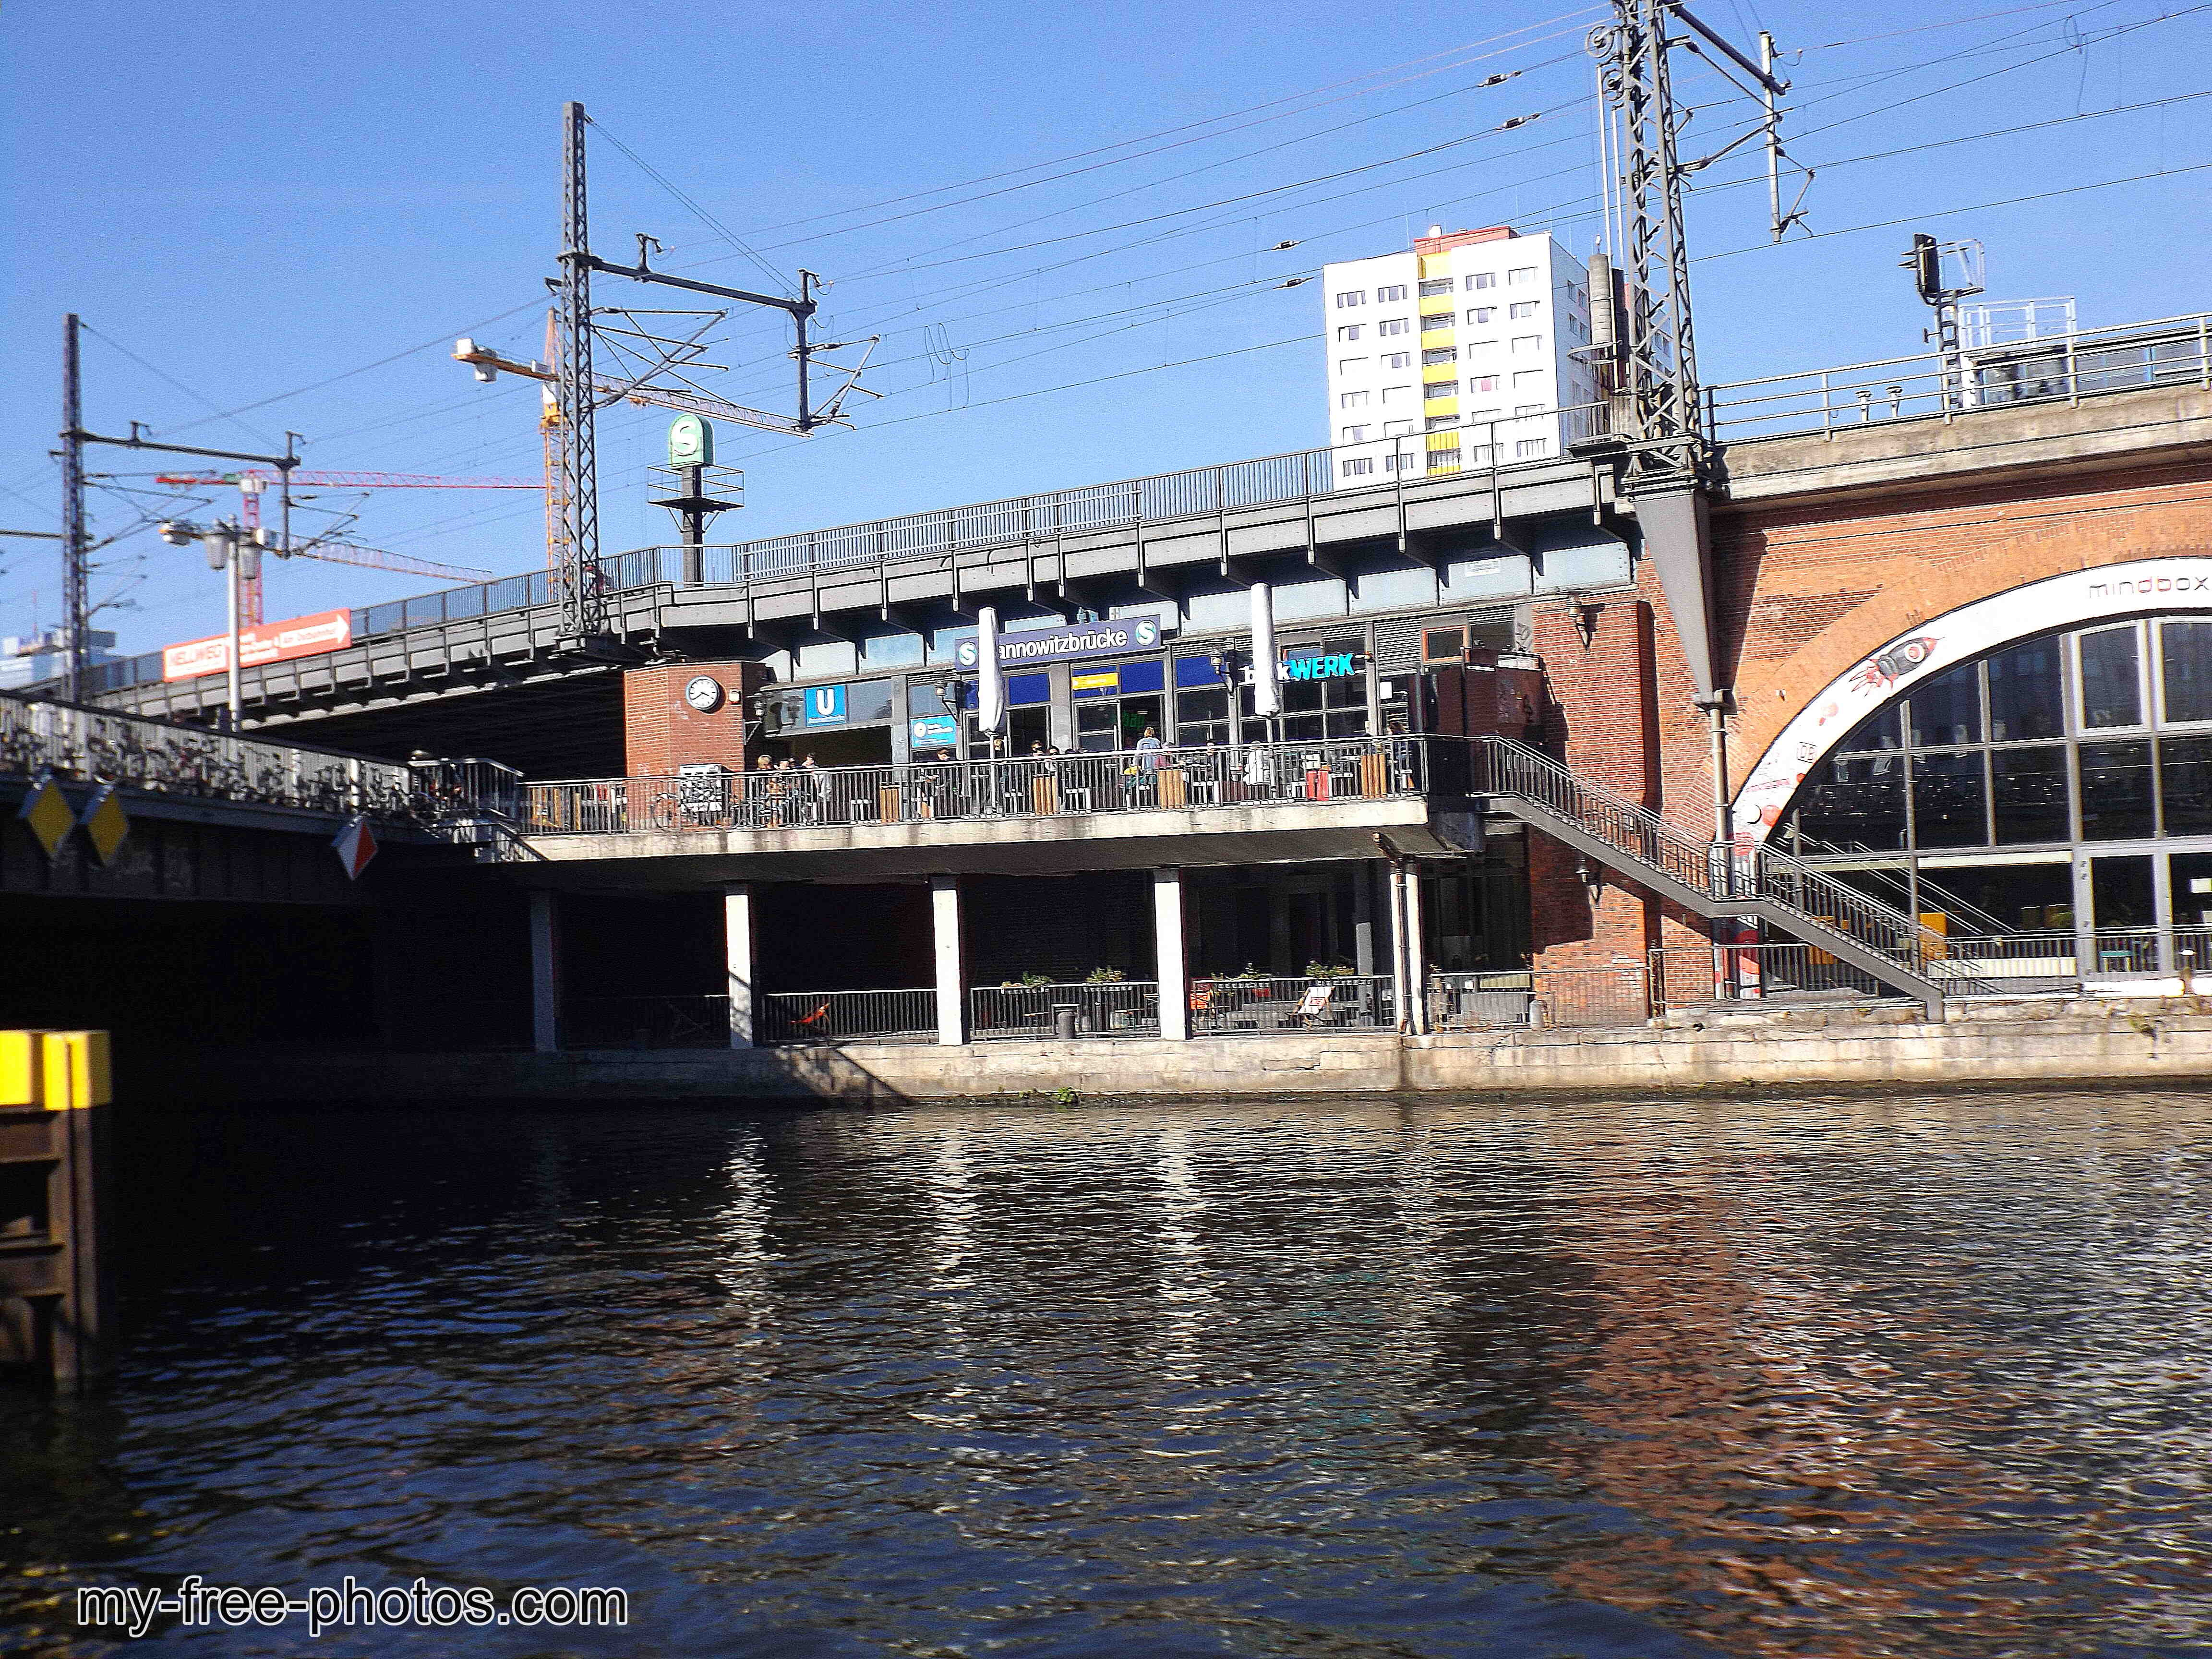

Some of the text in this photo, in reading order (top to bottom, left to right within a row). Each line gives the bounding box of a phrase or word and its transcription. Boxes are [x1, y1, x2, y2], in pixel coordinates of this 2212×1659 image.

[672, 421, 698, 456] S
[2089, 577, 2210, 599] mindbox
[959, 621, 1155, 665] S annowitzbrücke S
[817, 688, 834, 715] U
